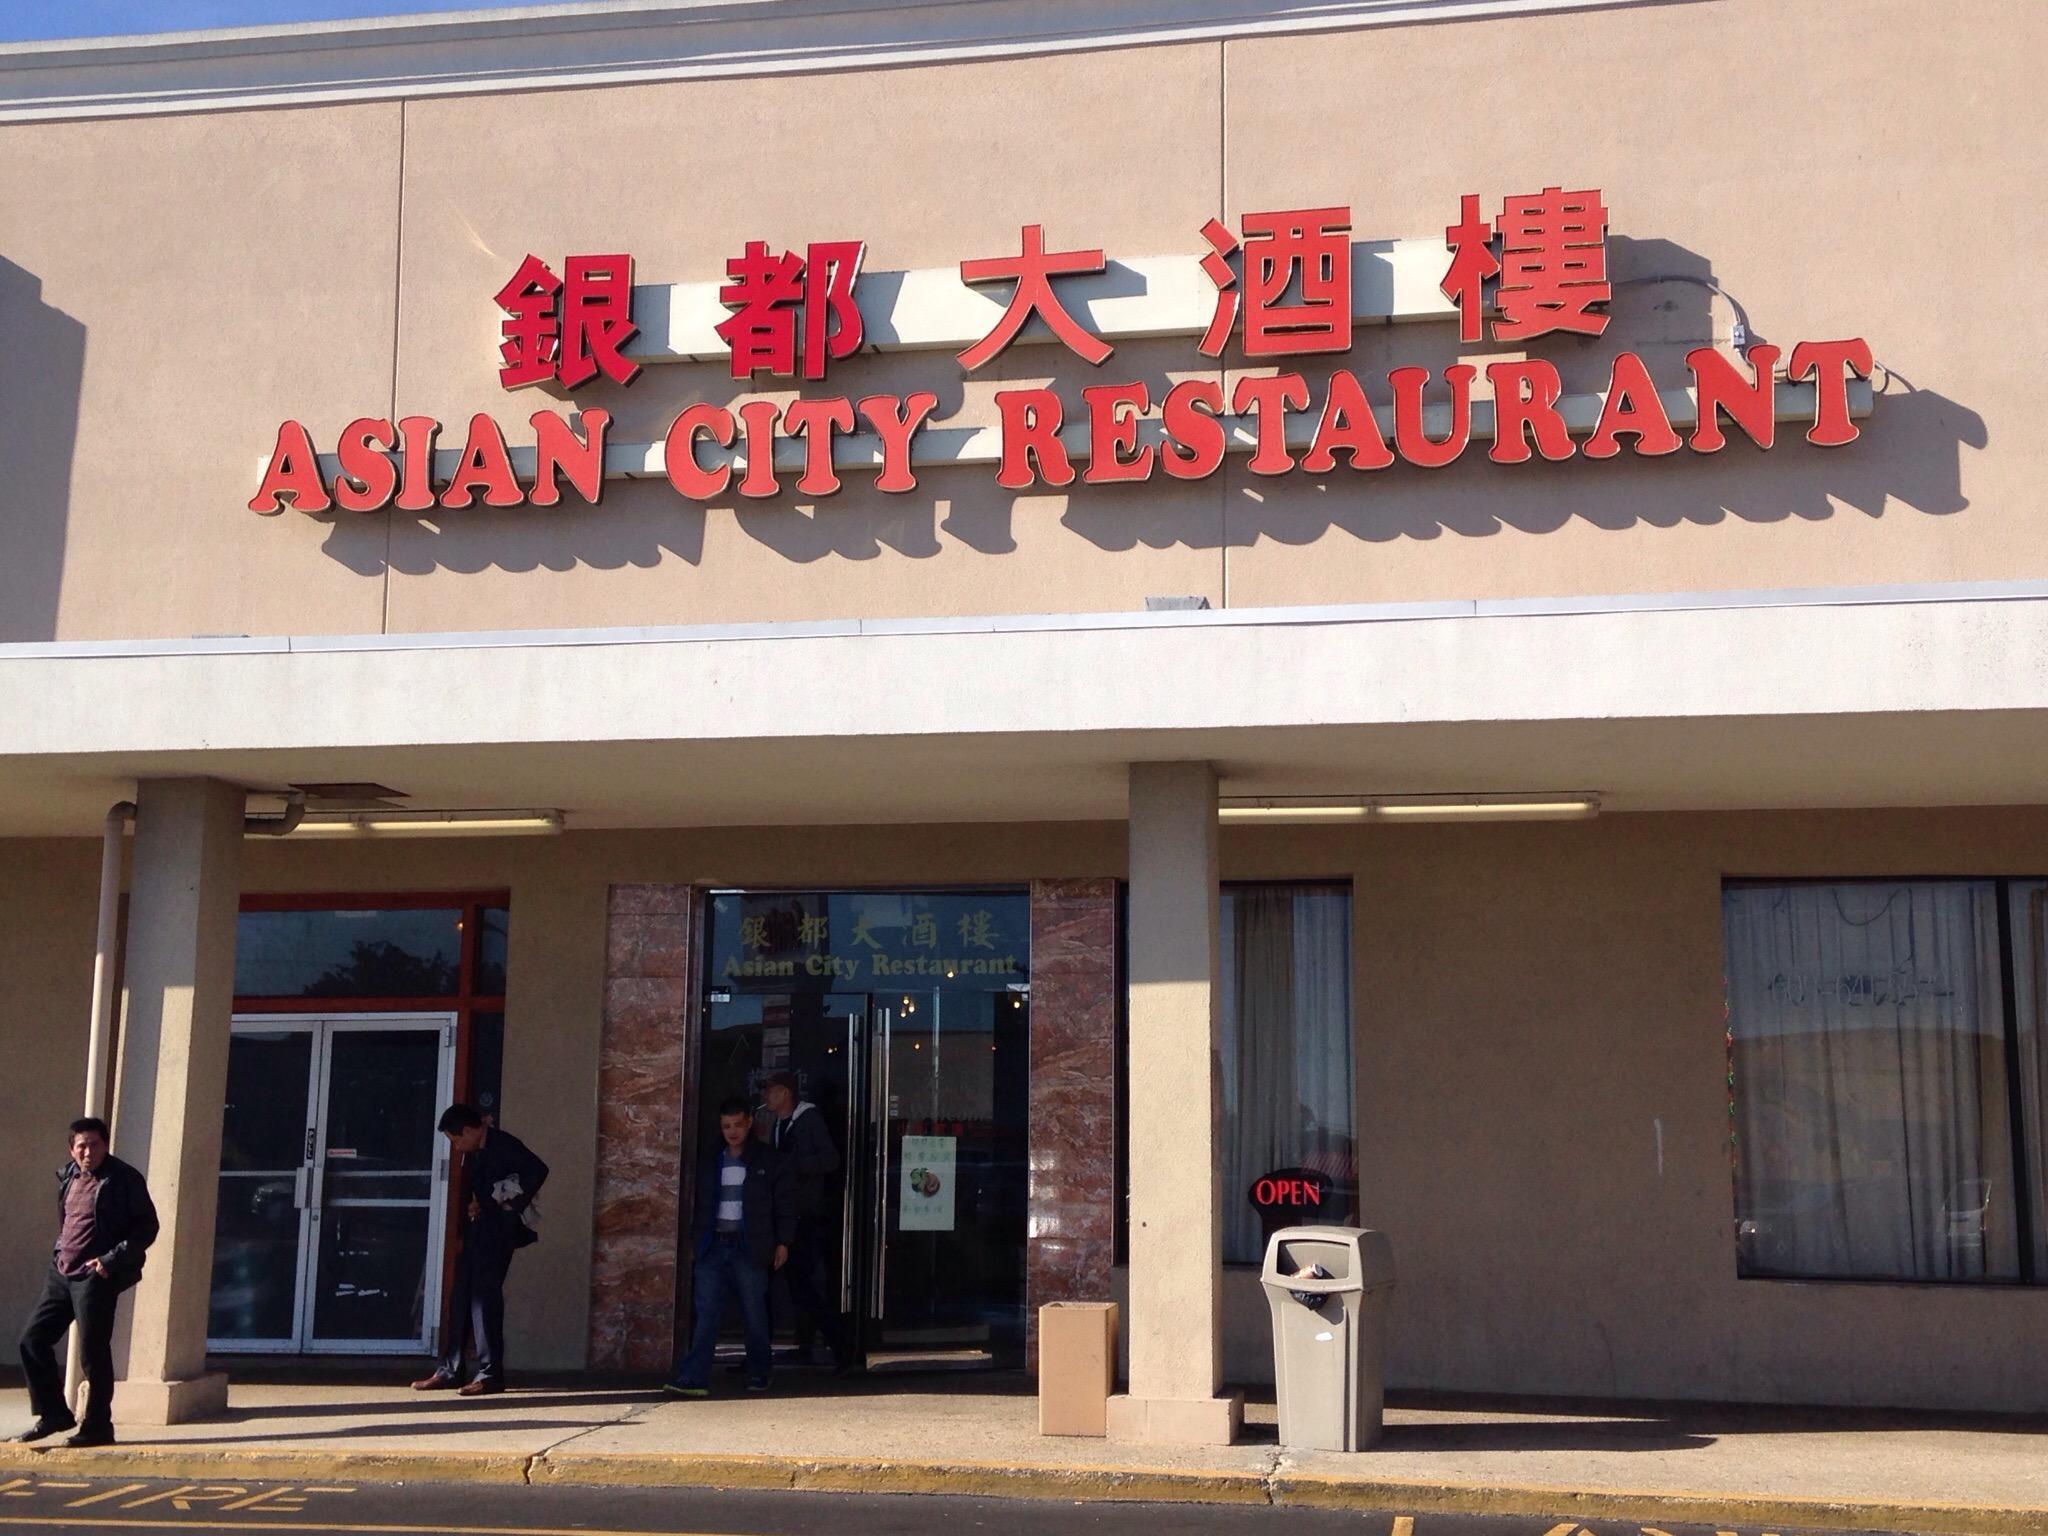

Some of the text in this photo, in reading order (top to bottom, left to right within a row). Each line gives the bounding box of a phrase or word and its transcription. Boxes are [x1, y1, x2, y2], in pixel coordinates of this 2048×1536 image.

[494, 186, 1612, 391] 銀都大酒樓
[248, 337, 1876, 516] ASIAN CITY RESTAURANT
[741, 913, 998, 949] 銀都大酒樓
[723, 954, 1017, 981] Asian City Restaurant
[1257, 1180, 1320, 1205] OPEN
